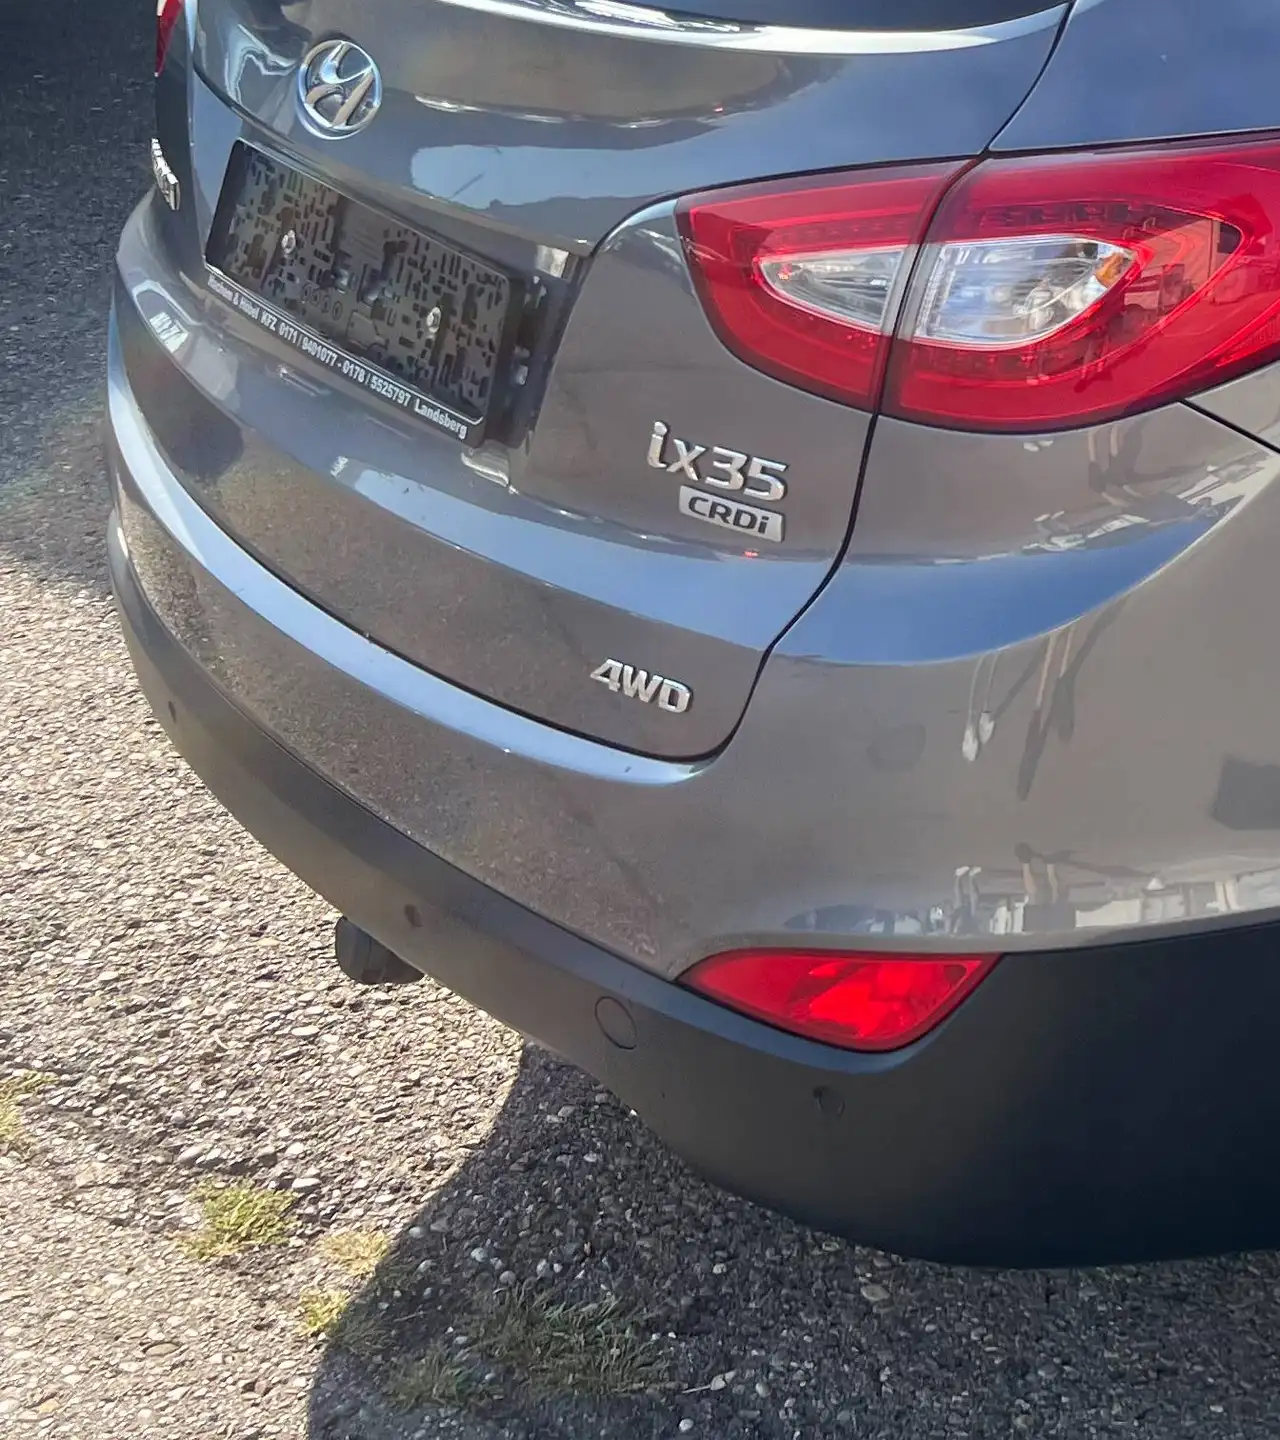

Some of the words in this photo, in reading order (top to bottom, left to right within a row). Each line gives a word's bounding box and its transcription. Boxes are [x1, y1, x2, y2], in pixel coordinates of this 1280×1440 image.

[260, 309, 278, 332] KFZ
[414, 398, 468, 440] Landsberg
[647, 421, 788, 501] ix35
[688, 496, 770, 535] CRDi
[589, 658, 694, 714] 4WD
